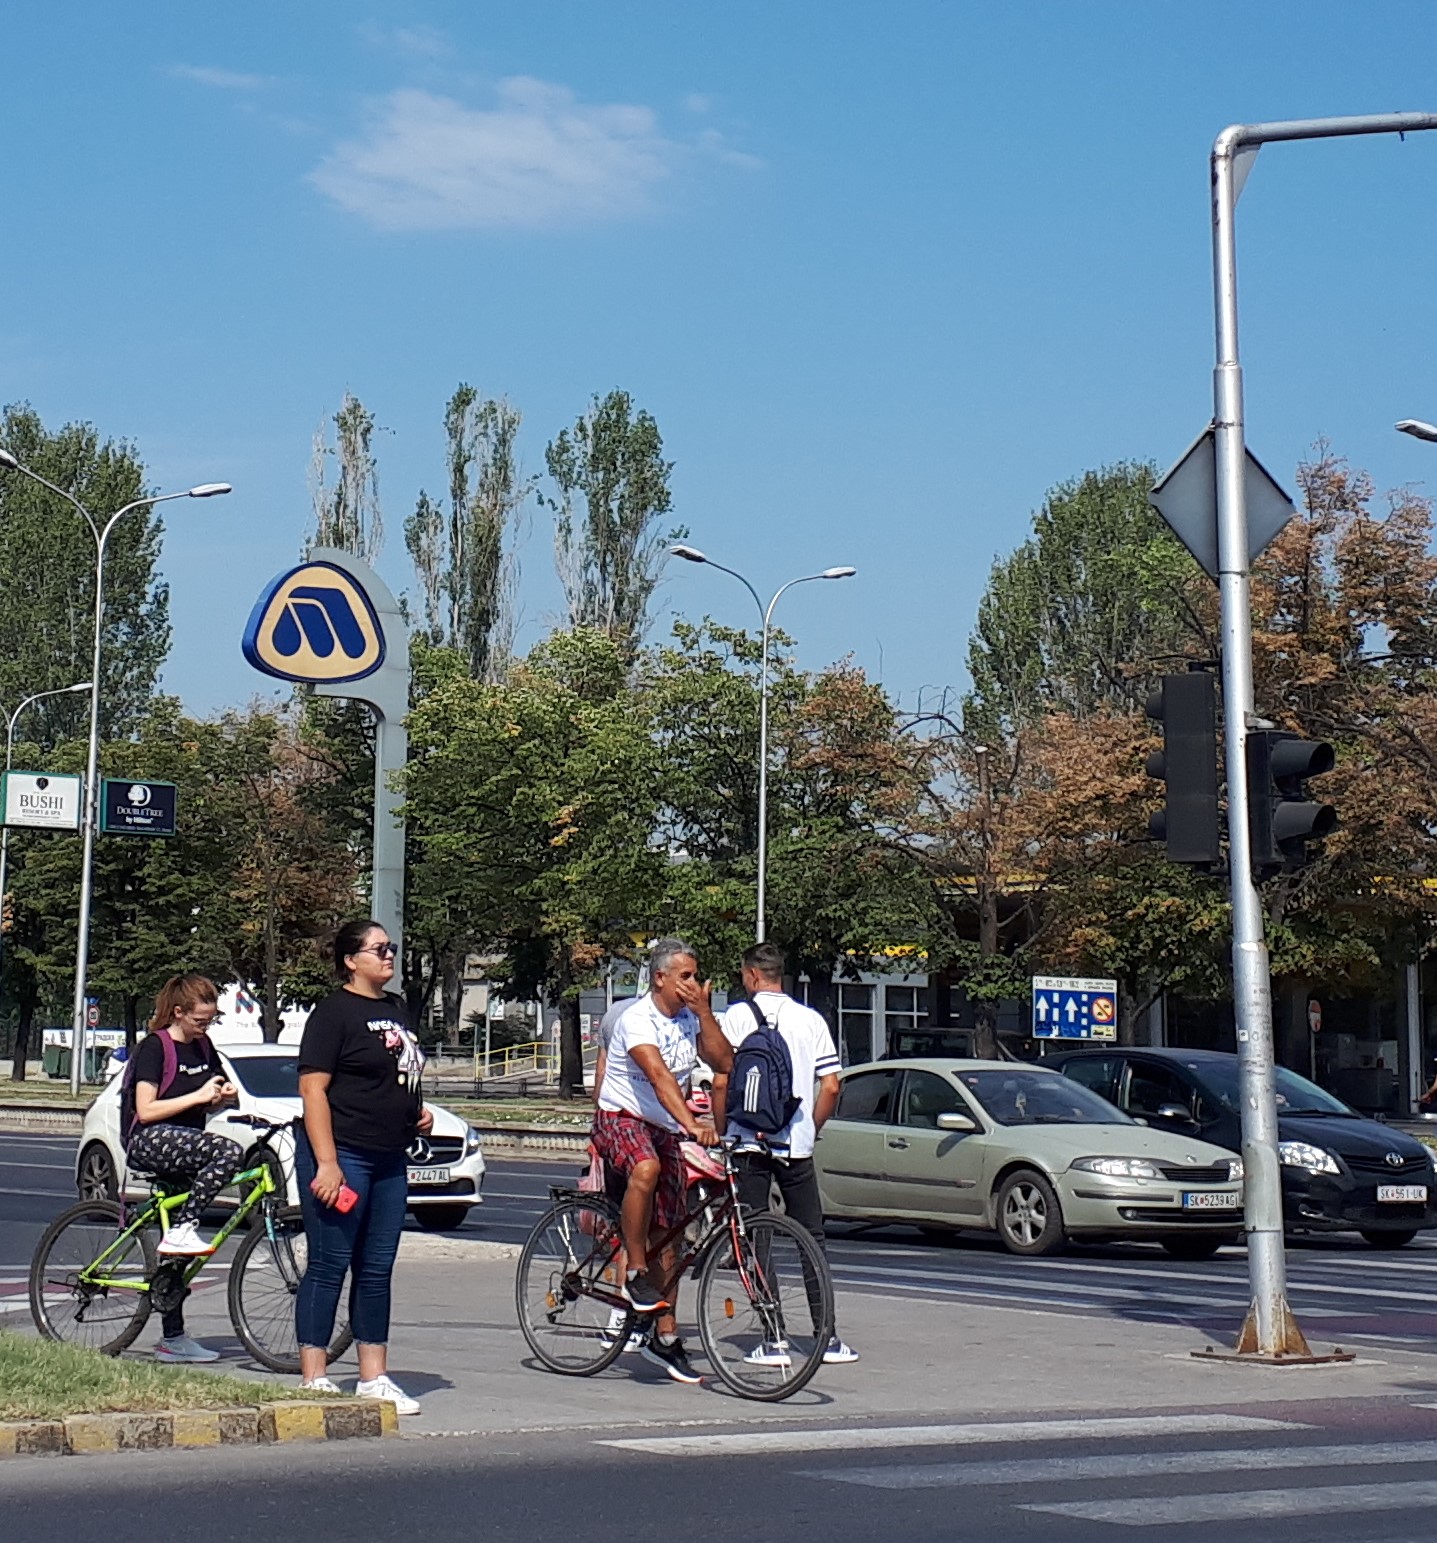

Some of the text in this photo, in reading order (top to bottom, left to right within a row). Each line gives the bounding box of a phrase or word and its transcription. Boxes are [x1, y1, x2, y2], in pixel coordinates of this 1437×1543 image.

[20, 794, 63, 809] BUSHI
[416, 1170, 437, 1180] 2447
[1189, 1194, 1200, 1206] SK
